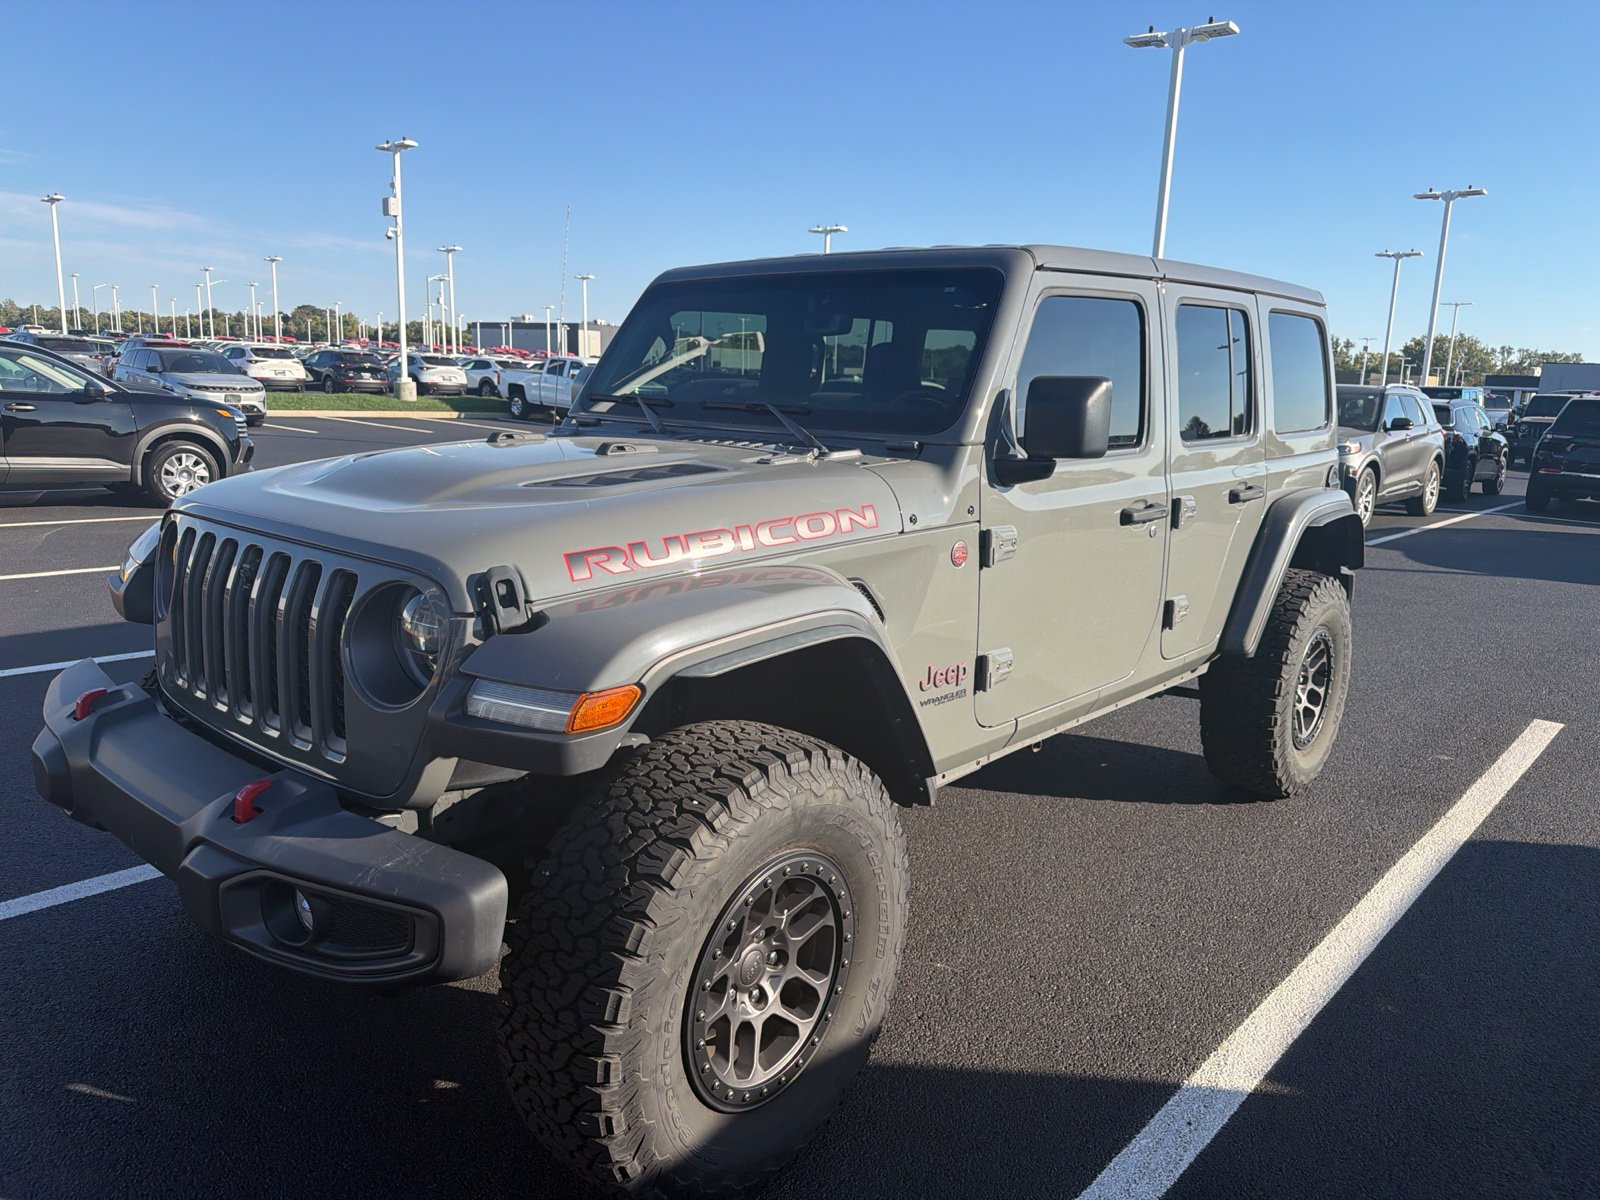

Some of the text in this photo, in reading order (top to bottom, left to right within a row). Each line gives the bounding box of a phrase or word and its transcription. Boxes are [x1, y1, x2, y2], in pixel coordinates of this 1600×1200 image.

[563, 504, 878, 582] RUBICON
[919, 662, 967, 692] Jeep
[919, 688, 967, 707] WRANGLER
[853, 976, 881, 1037] T/A
